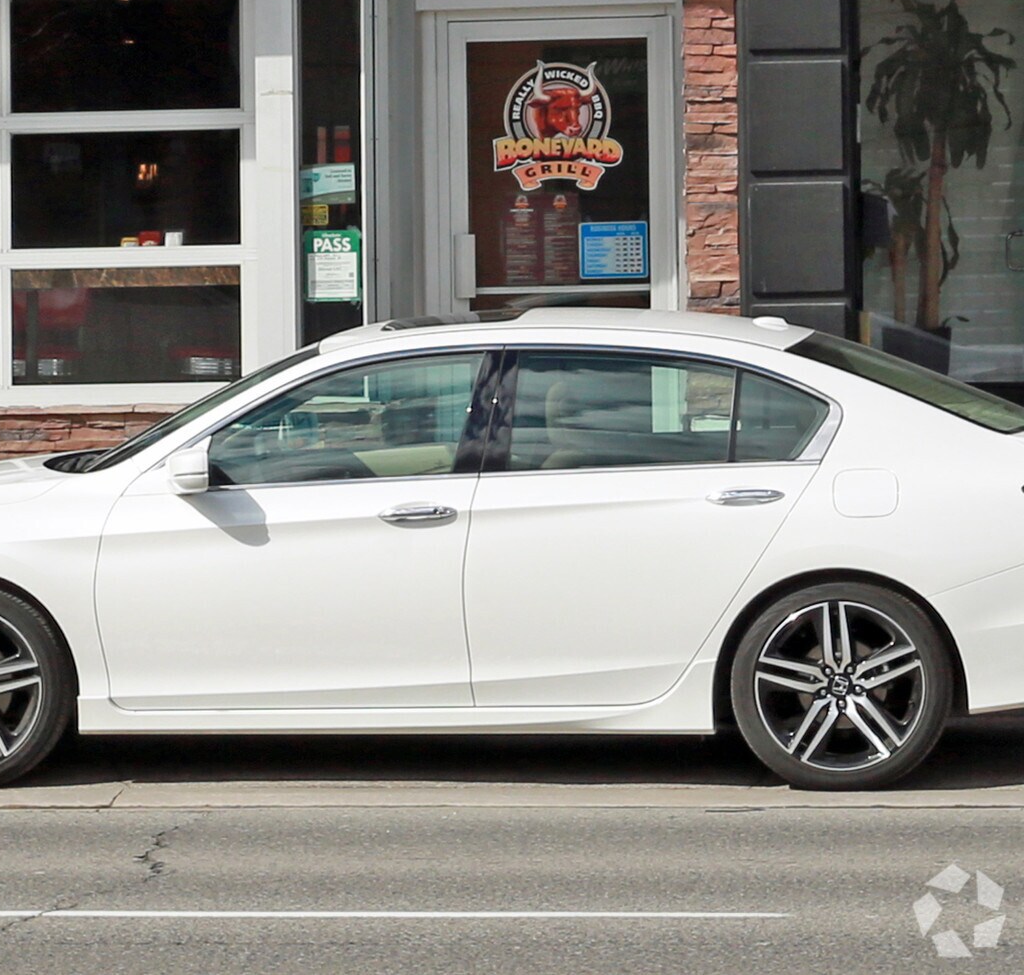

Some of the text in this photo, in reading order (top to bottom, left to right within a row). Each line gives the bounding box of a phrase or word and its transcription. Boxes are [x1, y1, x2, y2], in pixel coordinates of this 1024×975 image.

[511, 69, 604, 120] REALLY WICKED BBQ
[496, 138, 621, 168] BONEYARD
[524, 163, 592, 179] GRILL
[312, 237, 352, 253] PASS
